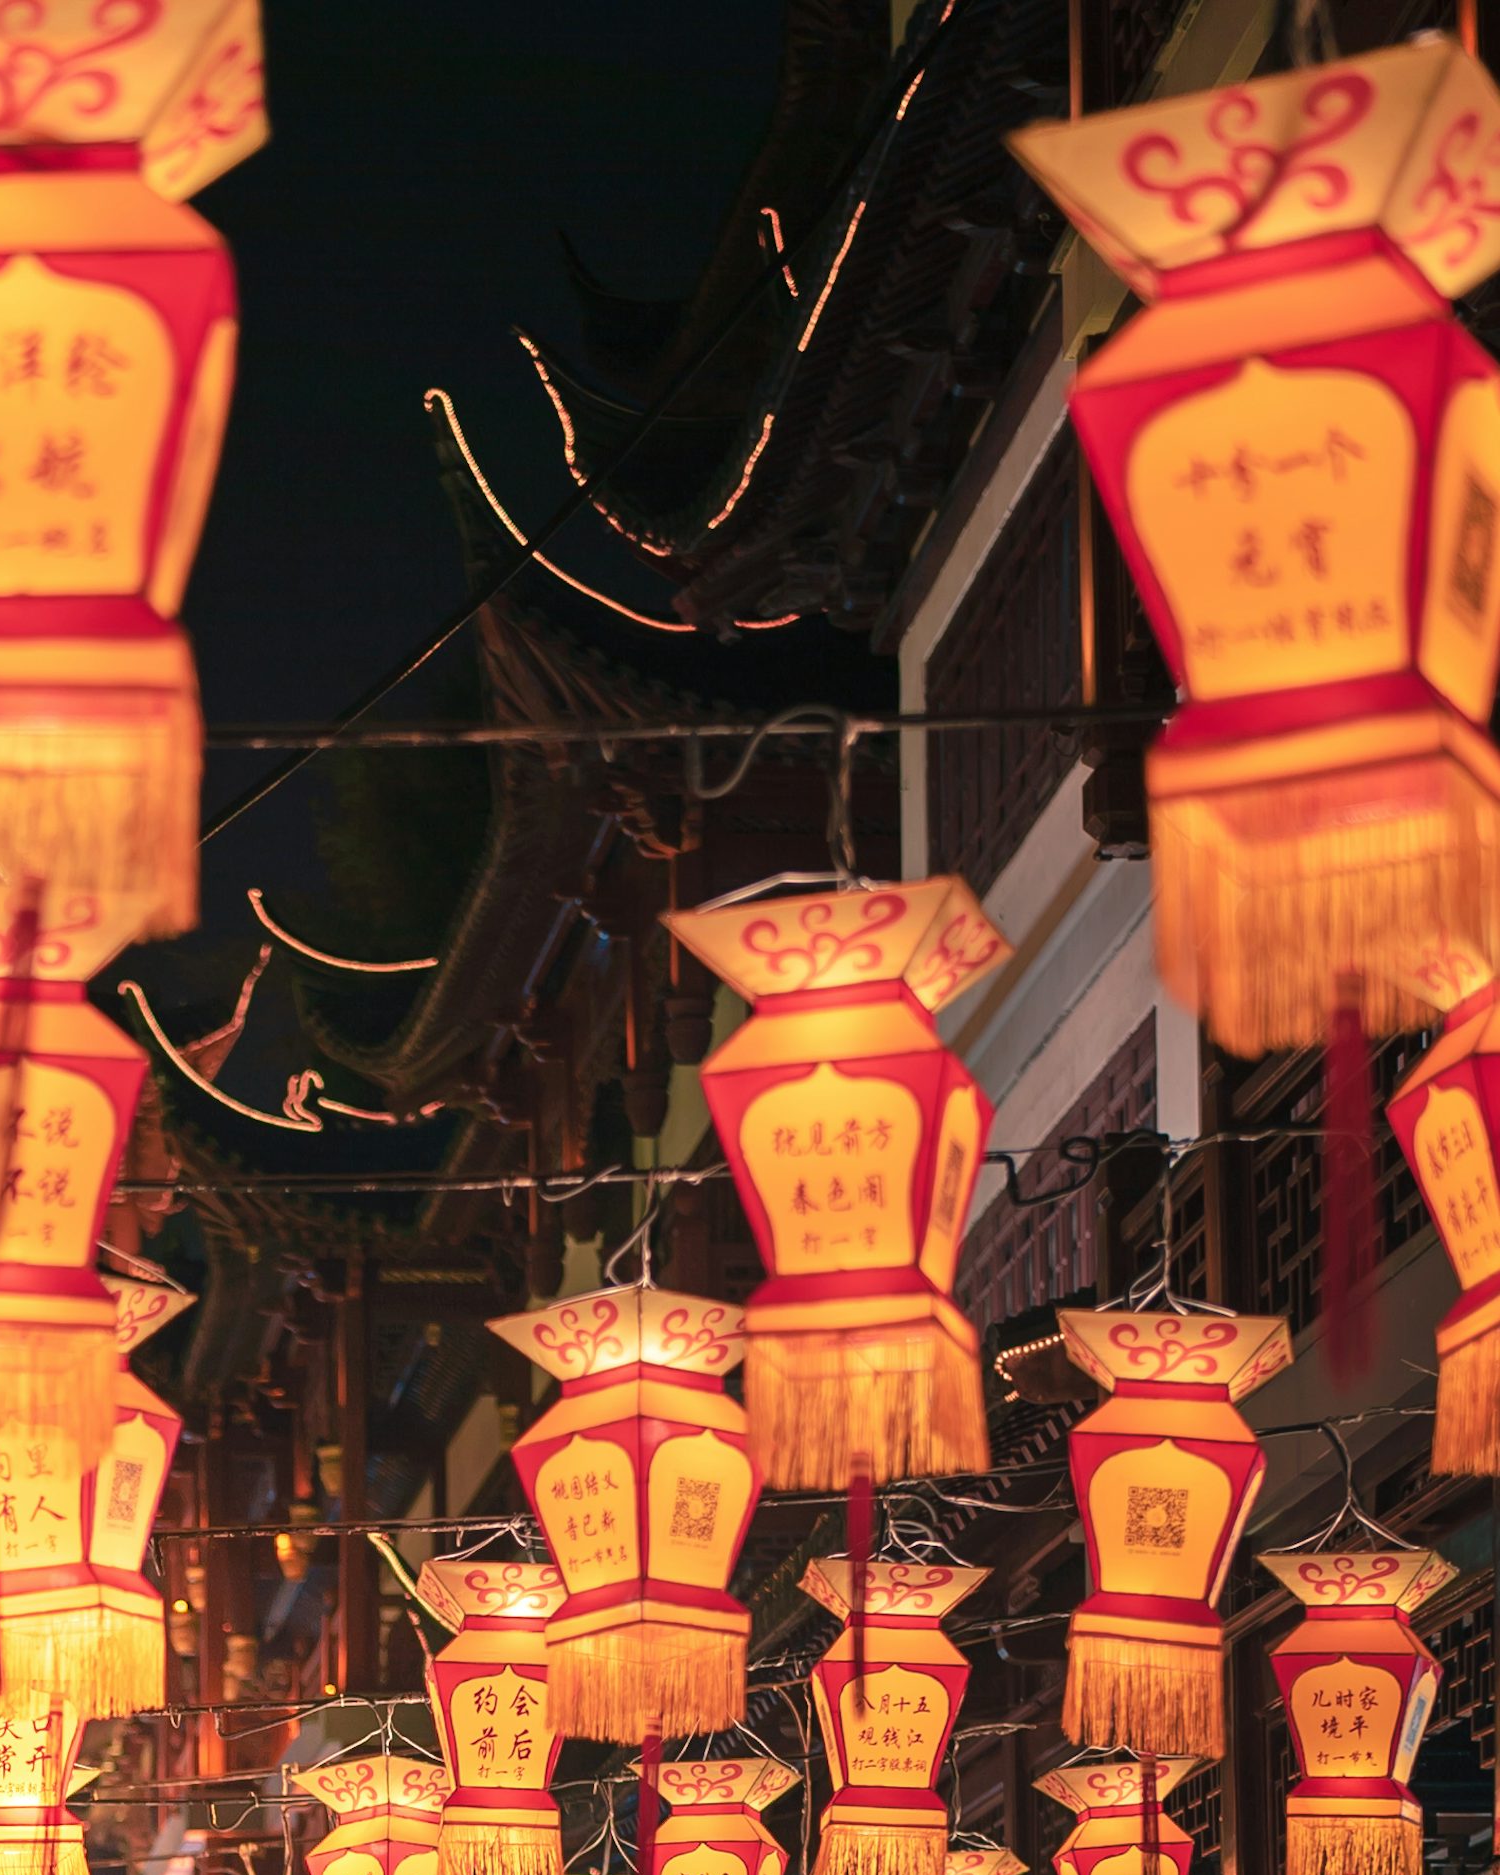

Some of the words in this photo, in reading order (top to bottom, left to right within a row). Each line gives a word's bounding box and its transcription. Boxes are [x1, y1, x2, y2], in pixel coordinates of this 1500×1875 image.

[802, 1226, 877, 1254] 打一字
[551, 1470, 619, 1501] 桃园结义
[6, 1534, 58, 1558] 打一字
[473, 1685, 539, 1717] 约会
[1311, 1685, 1379, 1711] 儿时家
[858, 1726, 925, 1749] 观钱江
[1320, 1715, 1369, 1740] 境平
[469, 1725, 533, 1763] 前后
[1316, 1751, 1378, 1767] 打一节气
[477, 1764, 526, 1781] 打一字
